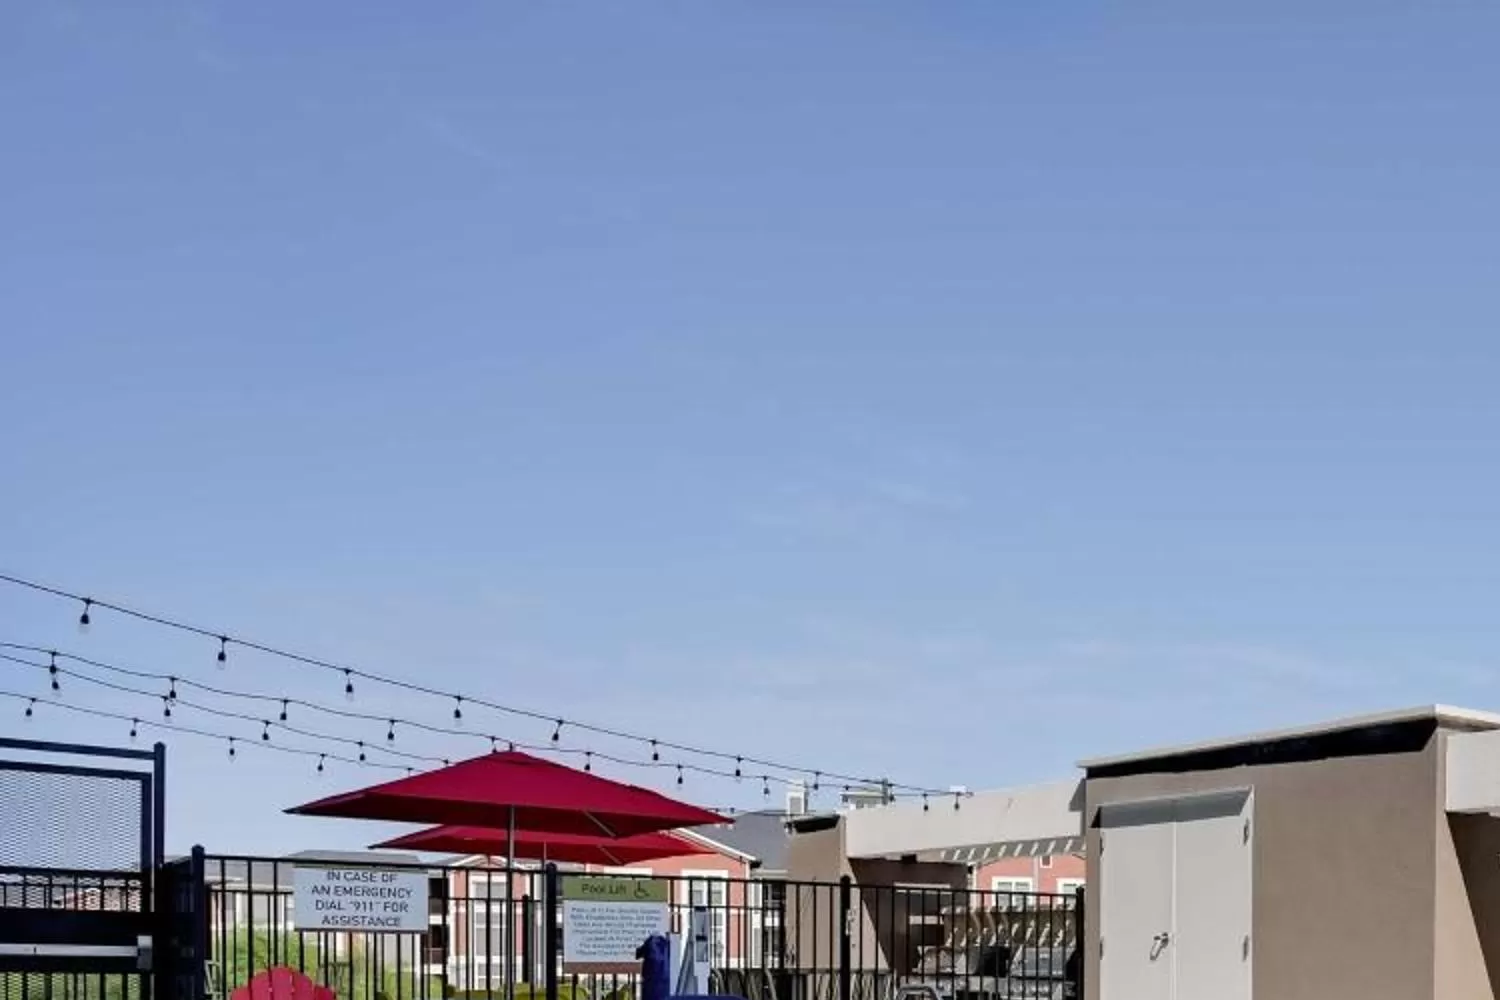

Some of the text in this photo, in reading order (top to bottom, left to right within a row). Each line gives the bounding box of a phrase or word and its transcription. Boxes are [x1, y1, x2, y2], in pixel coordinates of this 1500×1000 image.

[326, 868, 398, 883] IN CASE OF
[311, 884, 413, 899] AN EMERGENCY
[315, 899, 345, 911] DIAL
[383, 901, 409, 913] FOR
[321, 915, 401, 928] ASSISTANCE
